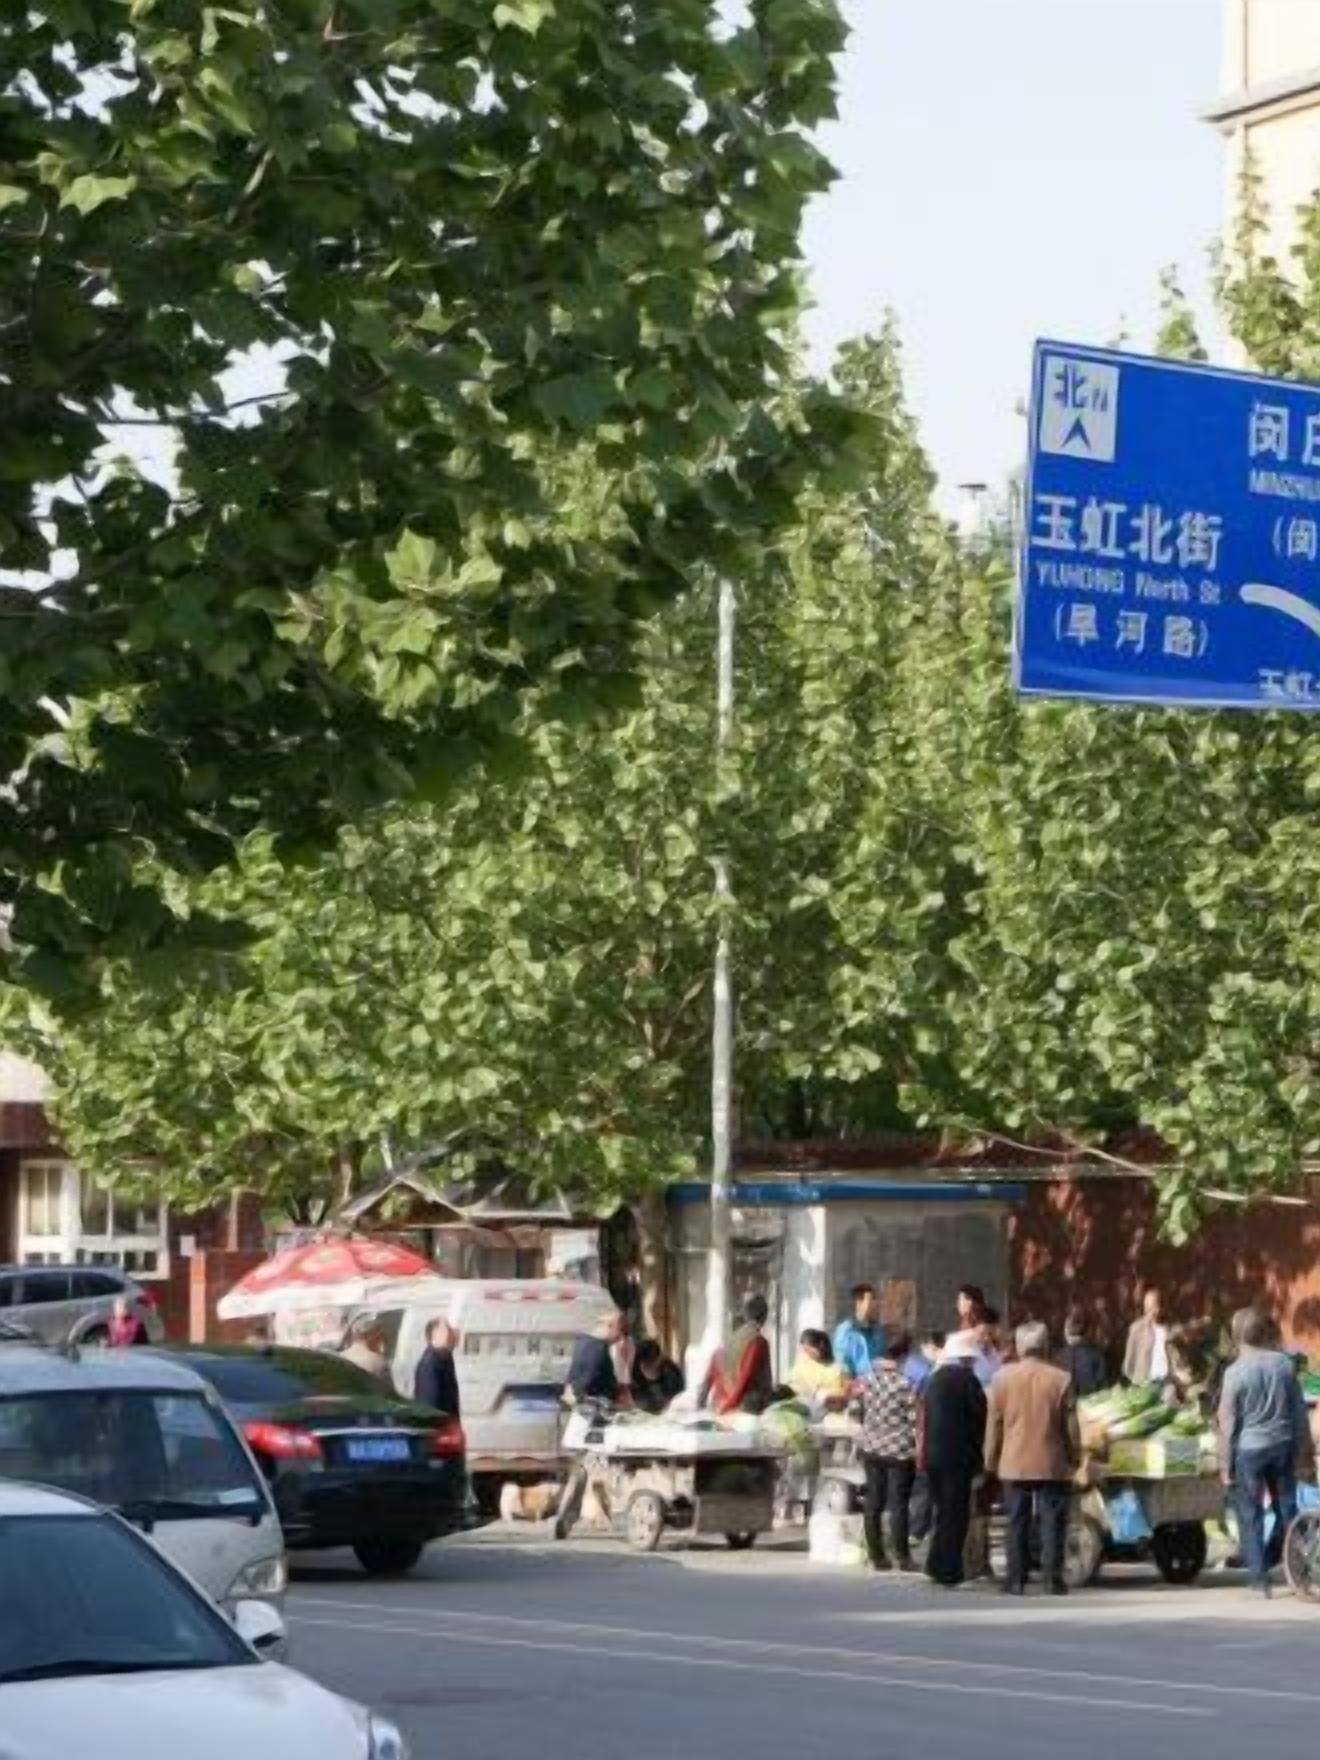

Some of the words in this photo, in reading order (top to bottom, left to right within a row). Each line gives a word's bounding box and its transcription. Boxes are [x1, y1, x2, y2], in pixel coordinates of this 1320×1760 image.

[1031, 494, 1223, 572] 玉虹北街
[1036, 560, 1125, 595] YUHONG
[1135, 571, 1189, 601] North
